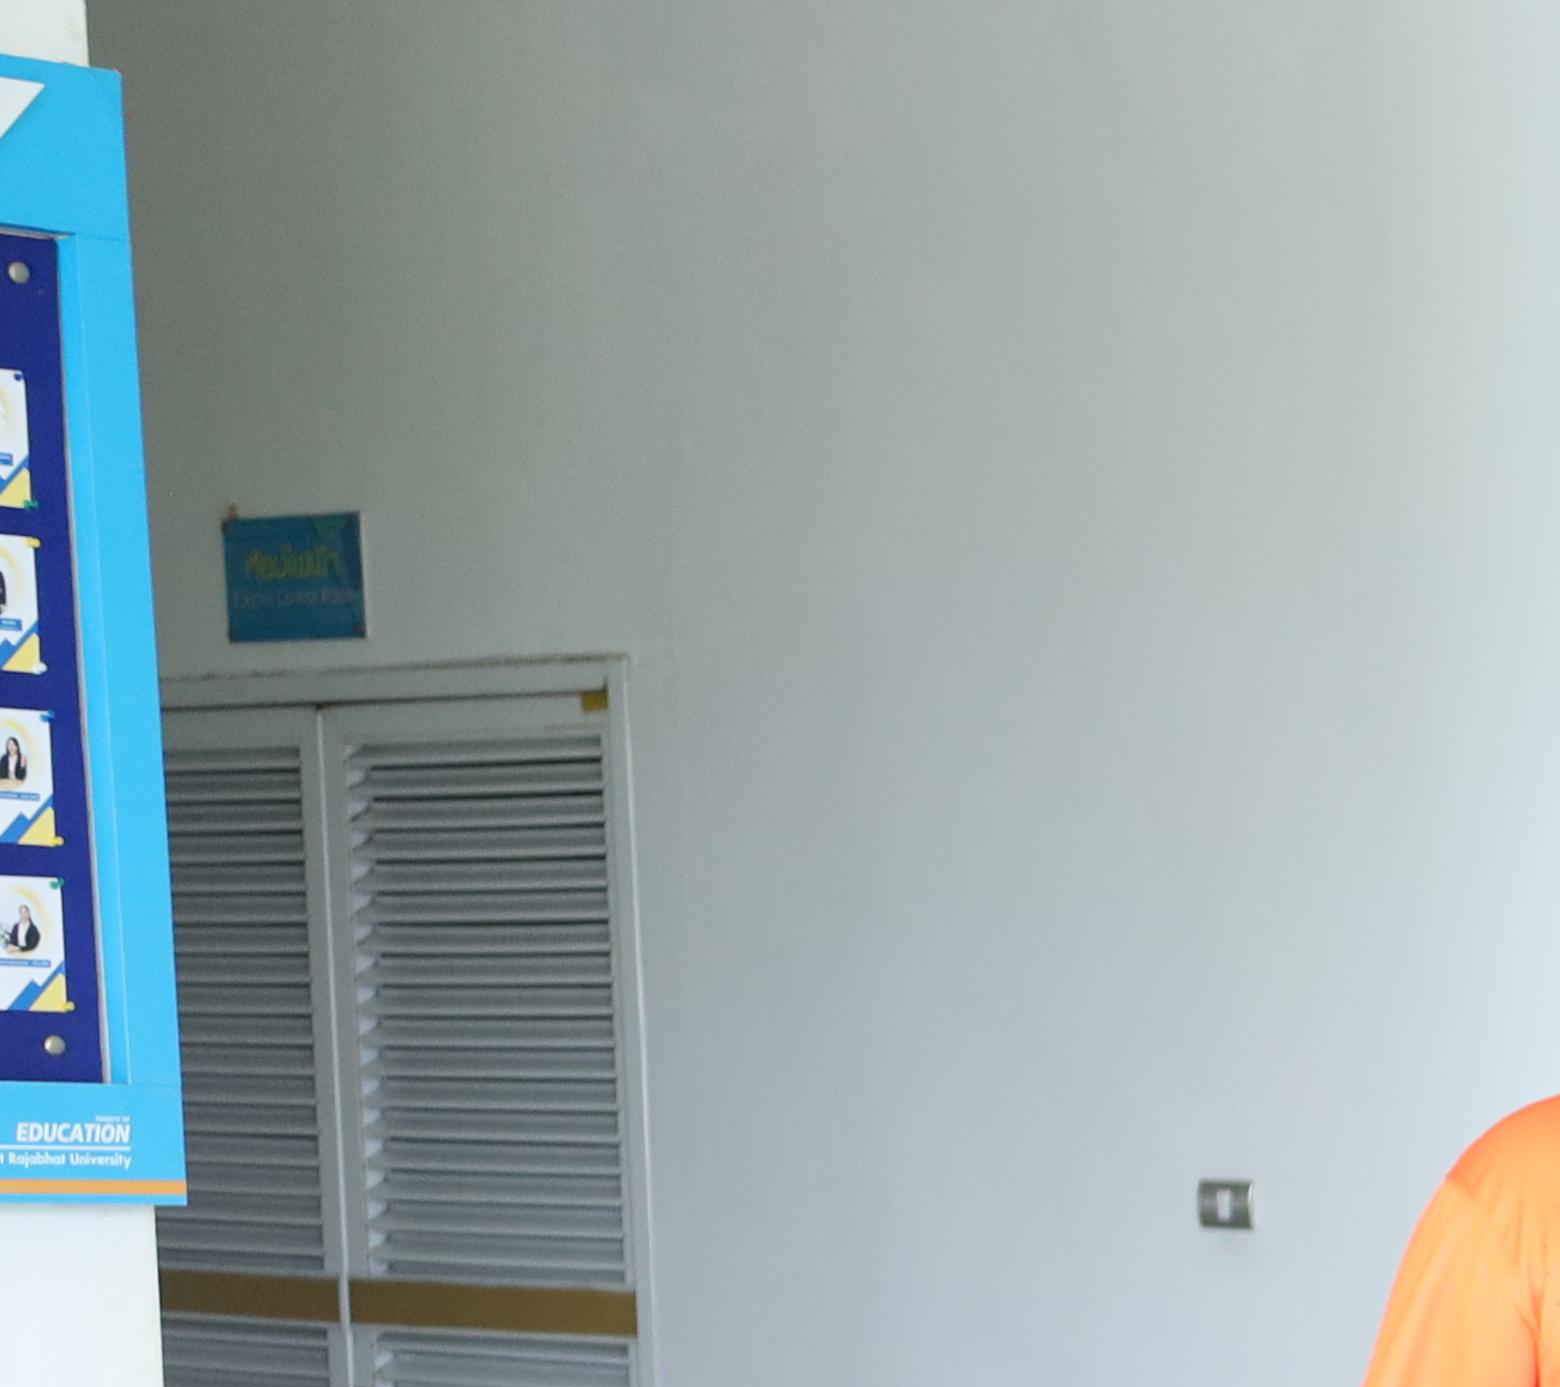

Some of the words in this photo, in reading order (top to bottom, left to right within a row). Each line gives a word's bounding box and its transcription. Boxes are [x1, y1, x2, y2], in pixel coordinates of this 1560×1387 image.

[16, 1121, 131, 1143] EDUCATION
[9, 1151, 66, 1169] Rajabhat
[70, 1153, 131, 1171] University
